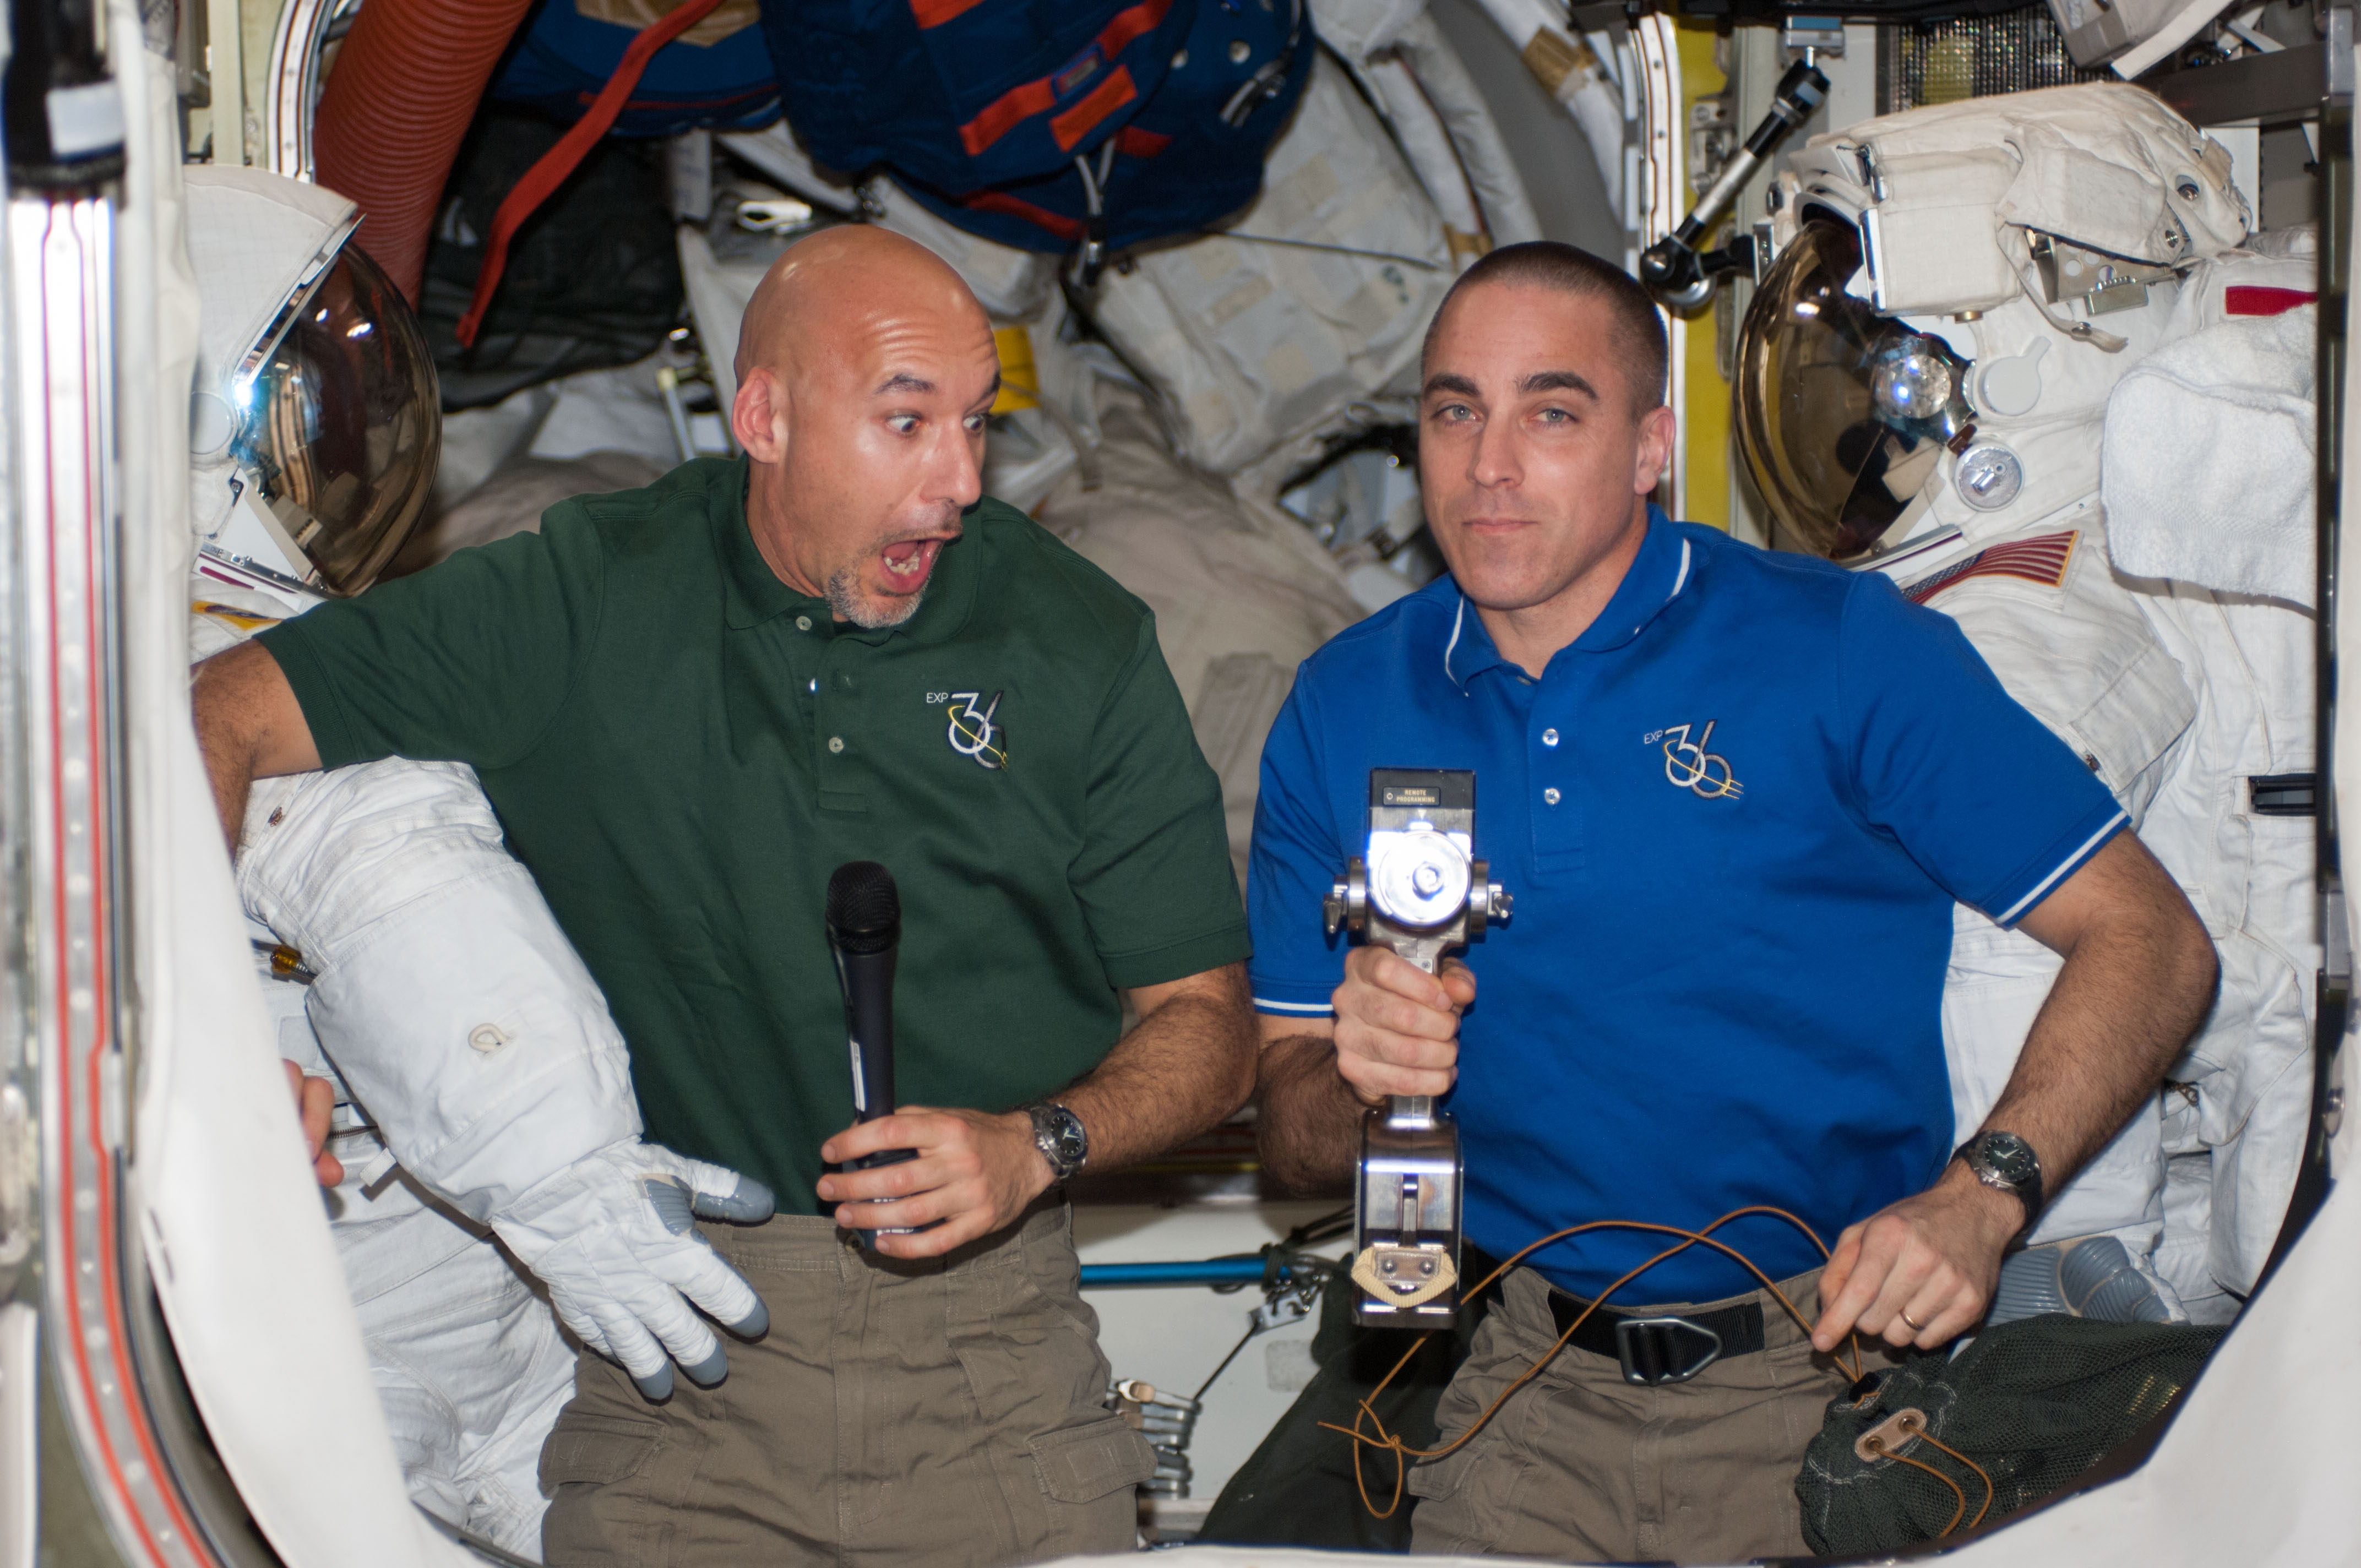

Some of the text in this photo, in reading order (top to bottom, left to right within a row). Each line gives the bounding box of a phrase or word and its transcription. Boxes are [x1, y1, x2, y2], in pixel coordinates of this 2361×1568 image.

[926, 690, 1006, 769] EXP 36
[1644, 719, 1733, 800] EXP 36
